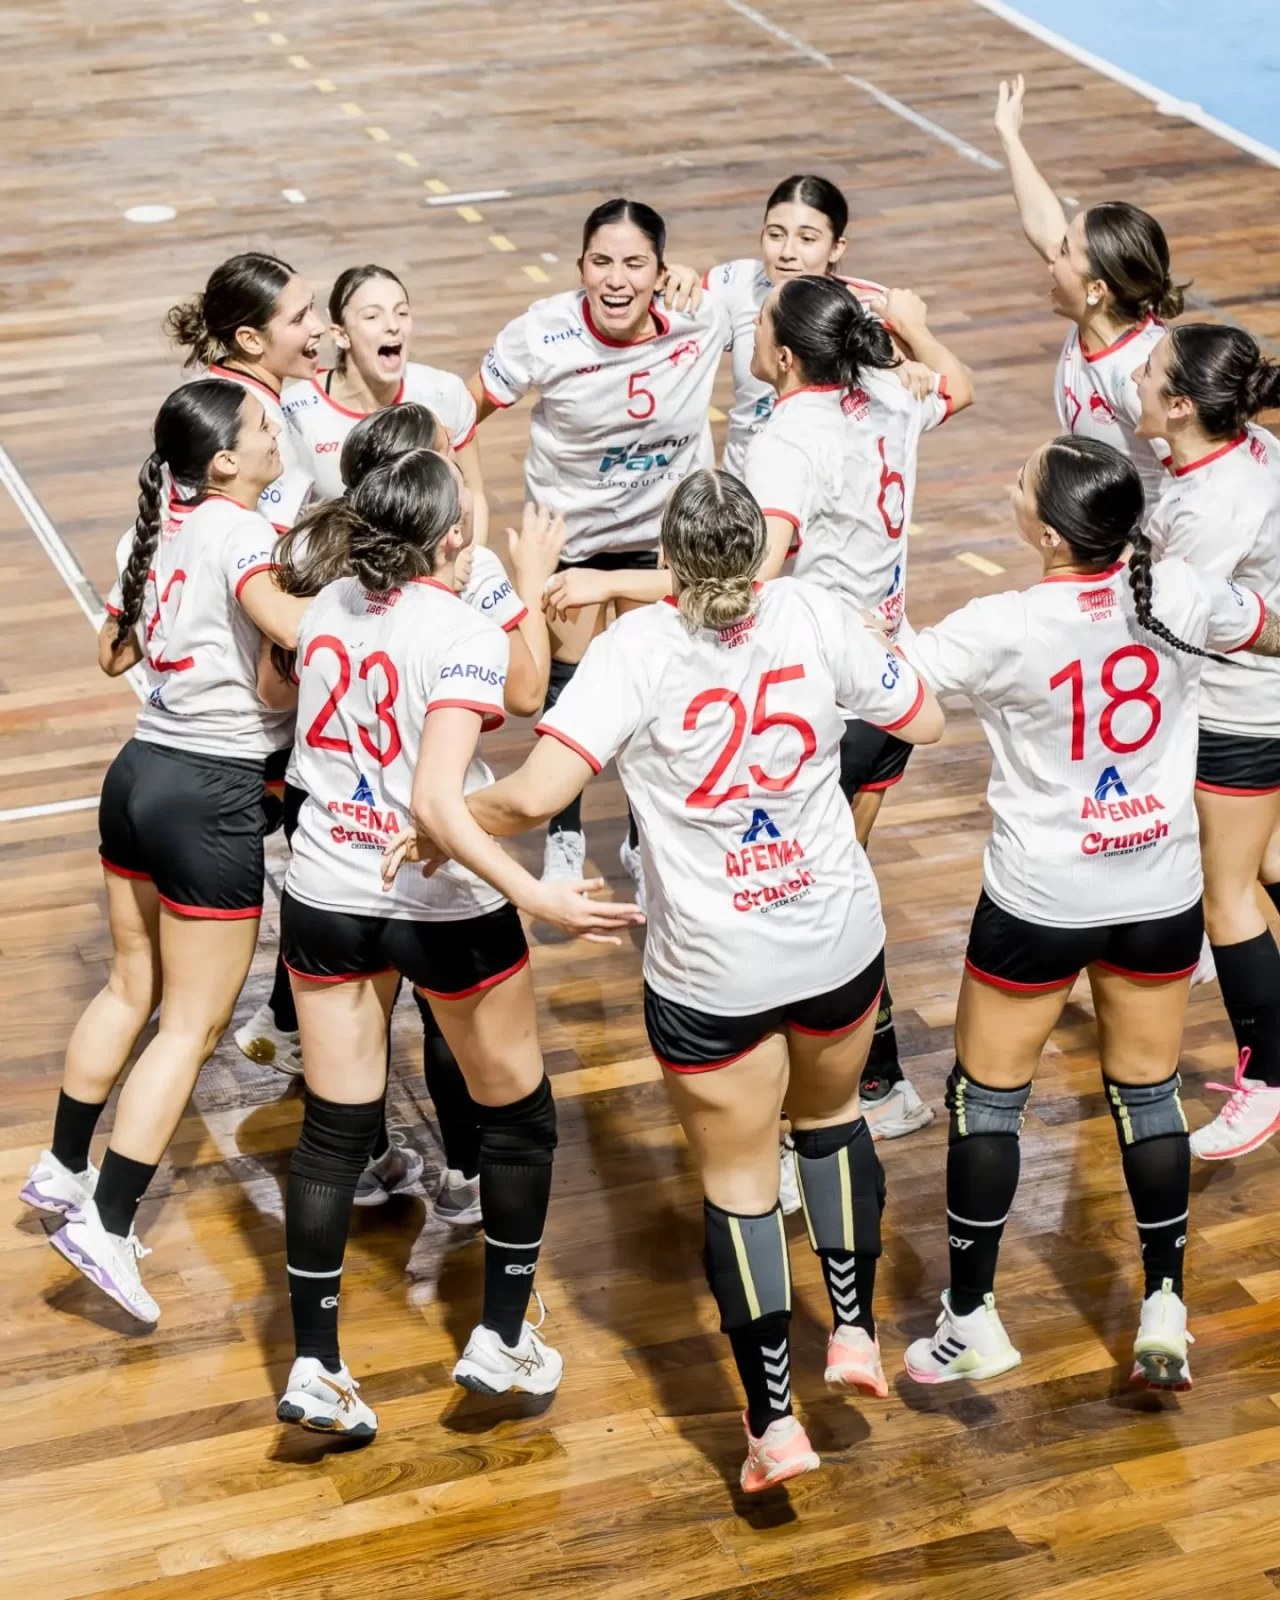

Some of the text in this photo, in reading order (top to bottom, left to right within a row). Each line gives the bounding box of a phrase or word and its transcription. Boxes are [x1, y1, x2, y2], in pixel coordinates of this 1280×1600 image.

[627, 371, 656, 420] 5
[315, 440, 341, 454] GO7
[877, 436, 905, 540] 6
[1091, 610, 1112, 622] 1887
[303, 634, 401, 768] 23
[1049, 643, 1162, 761] 18
[682, 663, 817, 809] 25
[1081, 793, 1167, 823] AFEMA
[330, 825, 389, 845] Crun
[1081, 818, 1169, 856] Crunch
[1104, 841, 1157, 858] CHICKEN STRIPS
[725, 838, 806, 878] AFEMA
[733, 868, 817, 912] Crunch
